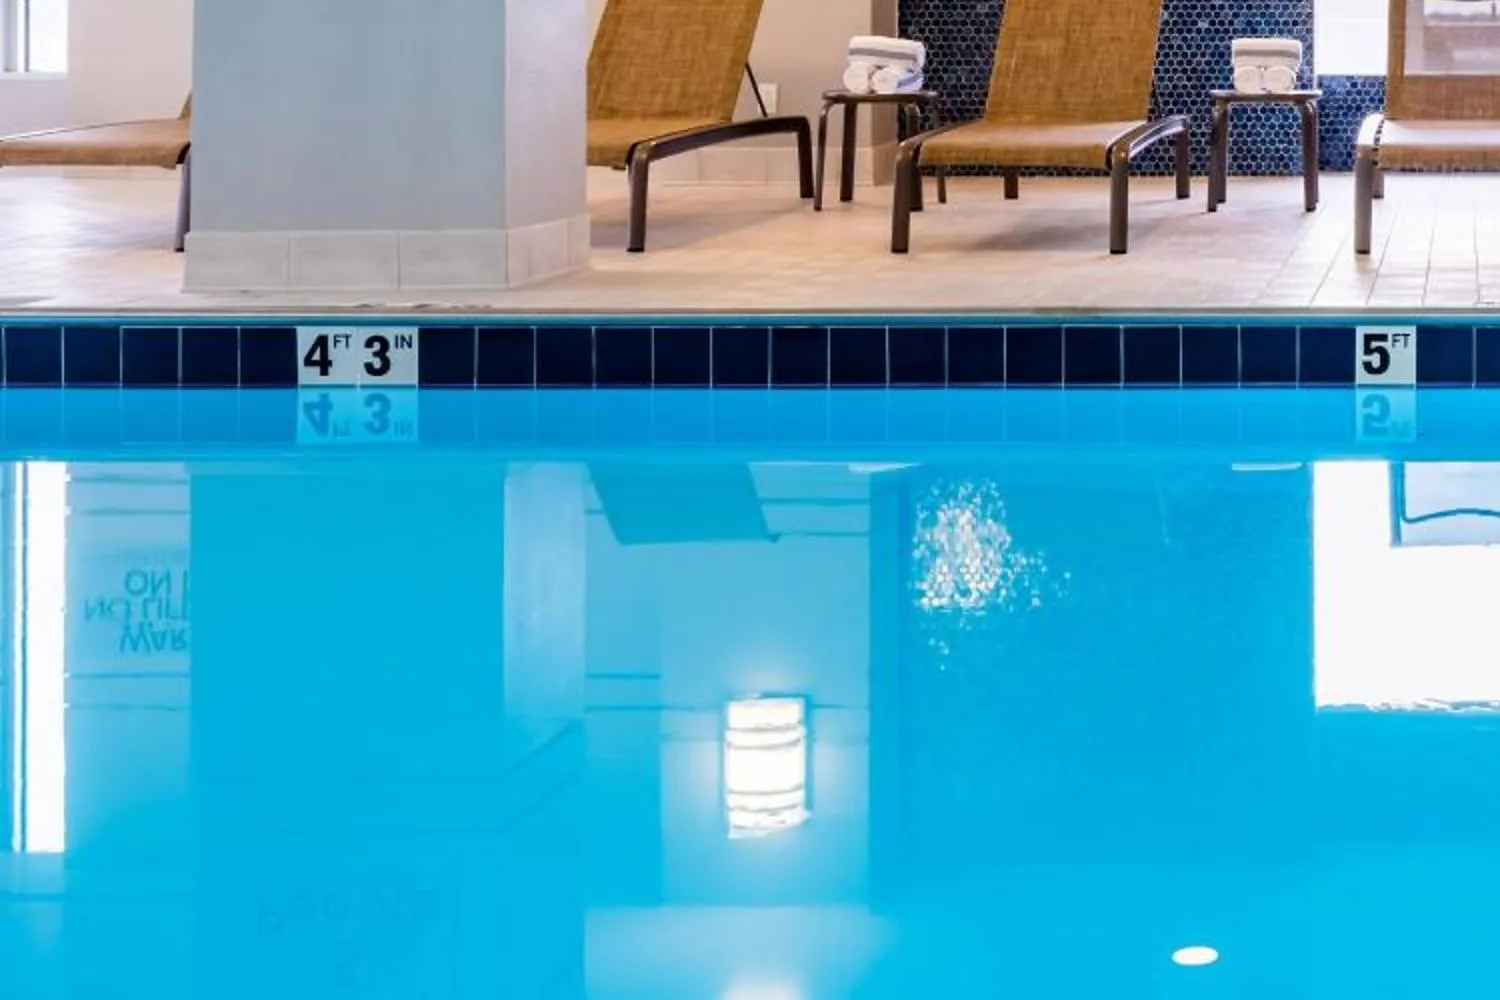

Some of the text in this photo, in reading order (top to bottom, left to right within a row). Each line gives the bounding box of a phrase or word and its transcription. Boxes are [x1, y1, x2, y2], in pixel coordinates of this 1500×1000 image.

[303, 333, 413, 377] 4 FT 3 IN
[1362, 333, 1411, 375] 5 FT
